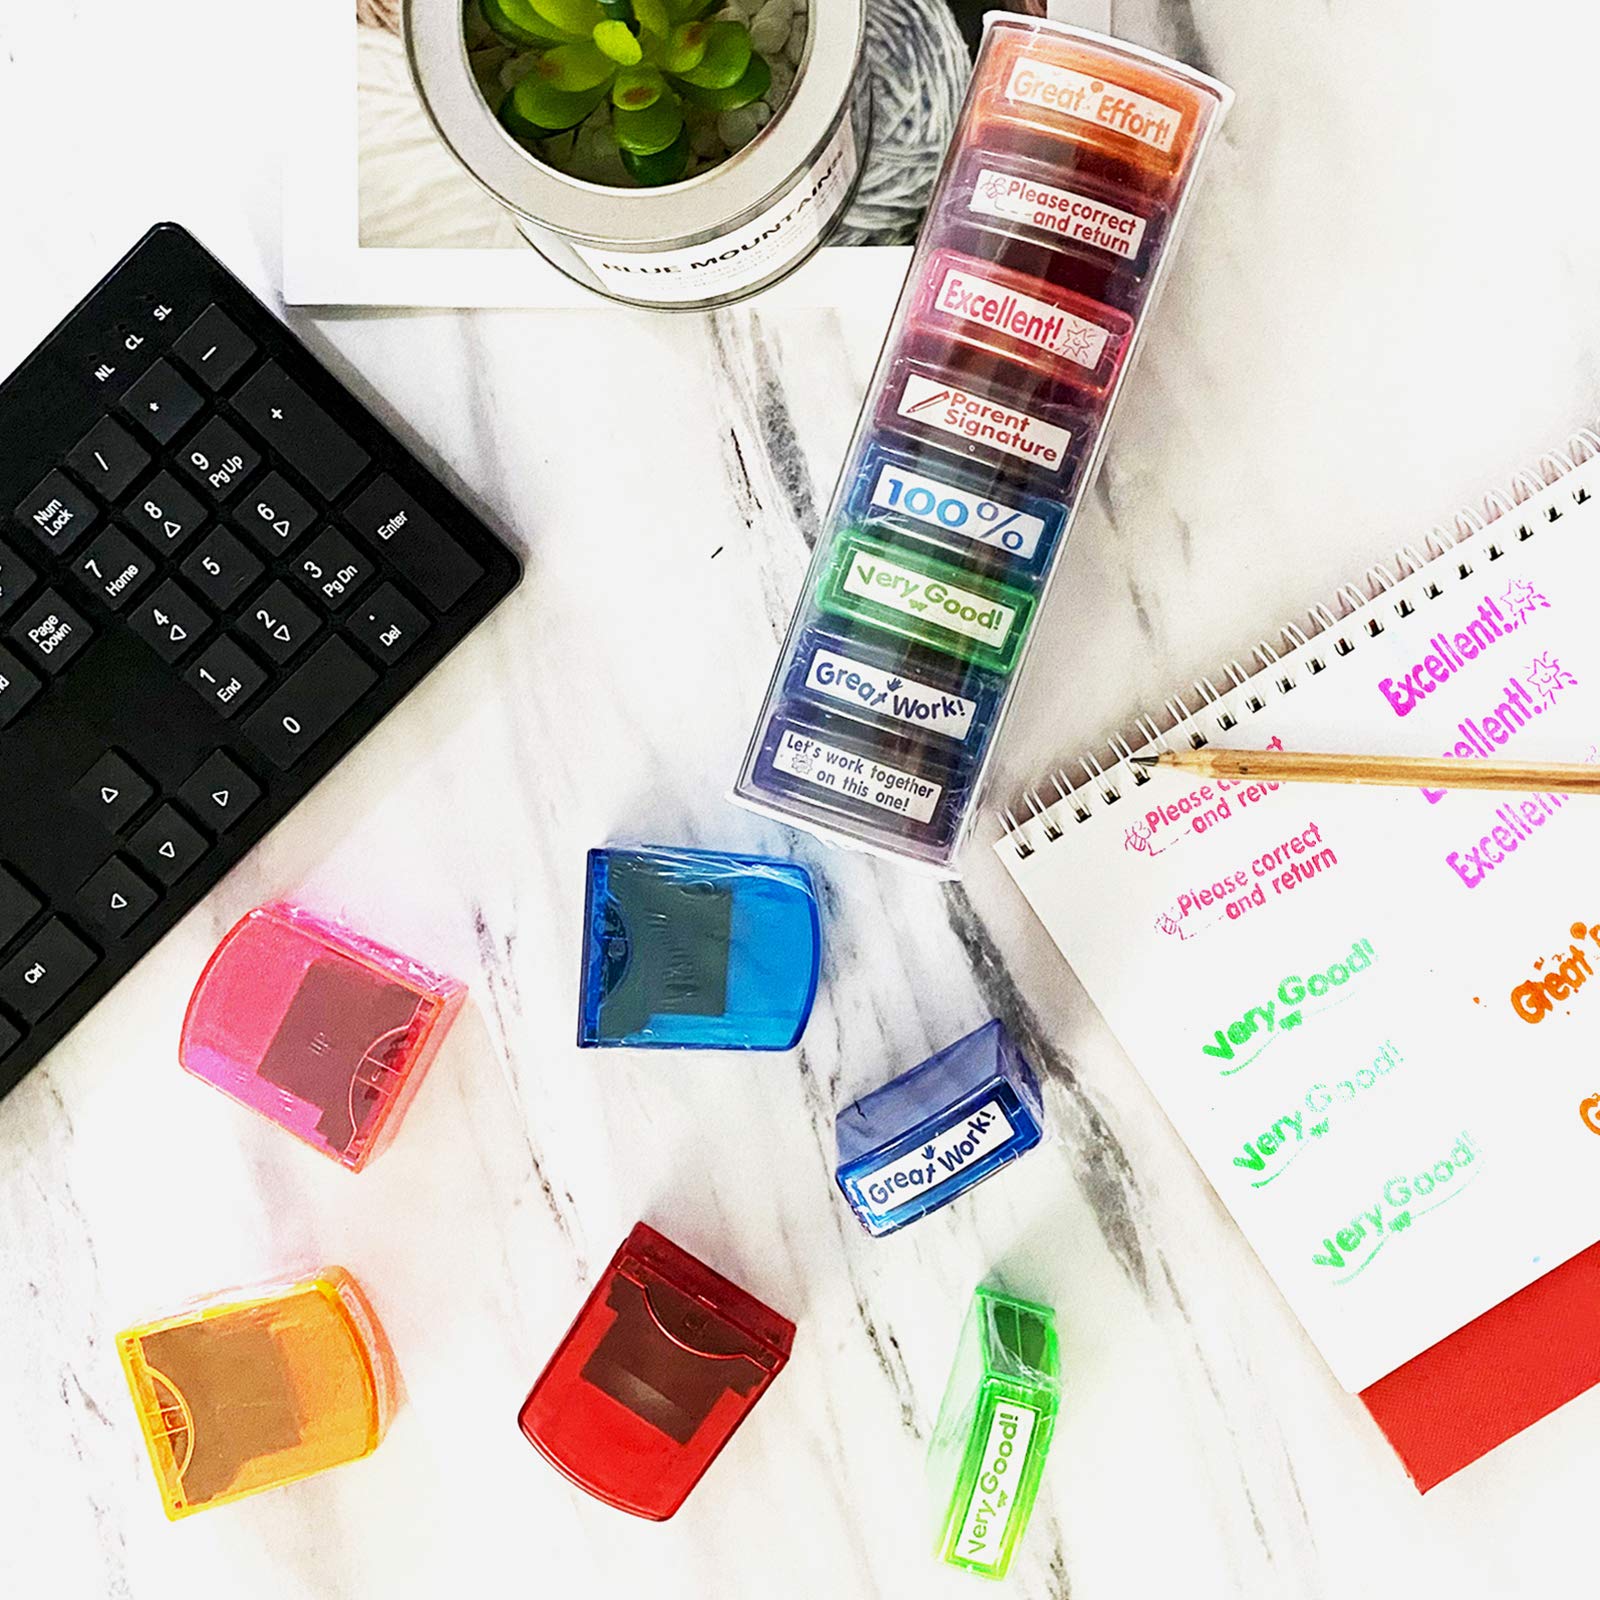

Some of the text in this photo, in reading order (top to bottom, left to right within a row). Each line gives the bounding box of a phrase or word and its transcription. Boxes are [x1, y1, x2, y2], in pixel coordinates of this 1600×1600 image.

[1013, 70, 1171, 144] Great Effort!
[1007, 180, 1136, 235] Please correct
[1033, 209, 1131, 254] and return
[154, 305, 172, 321] SL
[943, 279, 1064, 349] Excellent!
[126, 334, 144, 350] CL
[94, 364, 116, 382] NL
[951, 392, 1030, 432] Parent
[944, 408, 1057, 462] Signature
[190, 452, 209, 471] 9
[33, 498, 62, 526] Num
[43, 508, 74, 537] Lock
[143, 501, 163, 519] 8
[257, 503, 275, 521] 6
[377, 510, 408, 540] Enter
[889, 478, 1023, 550] 100%
[84, 559, 102, 578] 7
[105, 564, 139, 597] Home
[202, 556, 220, 576] 5
[303, 561, 323, 579] 3
[153, 608, 170, 626] 4
[857, 564, 1003, 631] Very Good!
[28, 614, 59, 644] Page
[38, 623, 72, 654] Down
[256, 609, 276, 629] 2
[379, 624, 402, 647] Del
[199, 668, 216, 684] 1
[1378, 596, 1513, 717] Excellent!
[216, 677, 242, 703] End
[816, 662, 966, 719] Great Work!
[282, 716, 301, 734] 0
[1420, 677, 1542, 804] ellent!
[787, 733, 934, 799] Let's work together
[817, 769, 910, 812] on this one!
[1145, 785, 1214, 833] Please
[1192, 781, 1286, 833] and retu
[1446, 792, 1569, 889] Excellen
[1177, 822, 1323, 916] Please correct
[1226, 847, 1338, 920] and return
[24, 962, 46, 984] Ctrl
[1202, 938, 1379, 1060] Very Good!
[1232, 1040, 1404, 1171] Very Good!
[868, 1110, 996, 1204] Great Work!
[1312, 1130, 1482, 1268] Very Good!
[968, 1412, 1019, 1554] Very Good!
